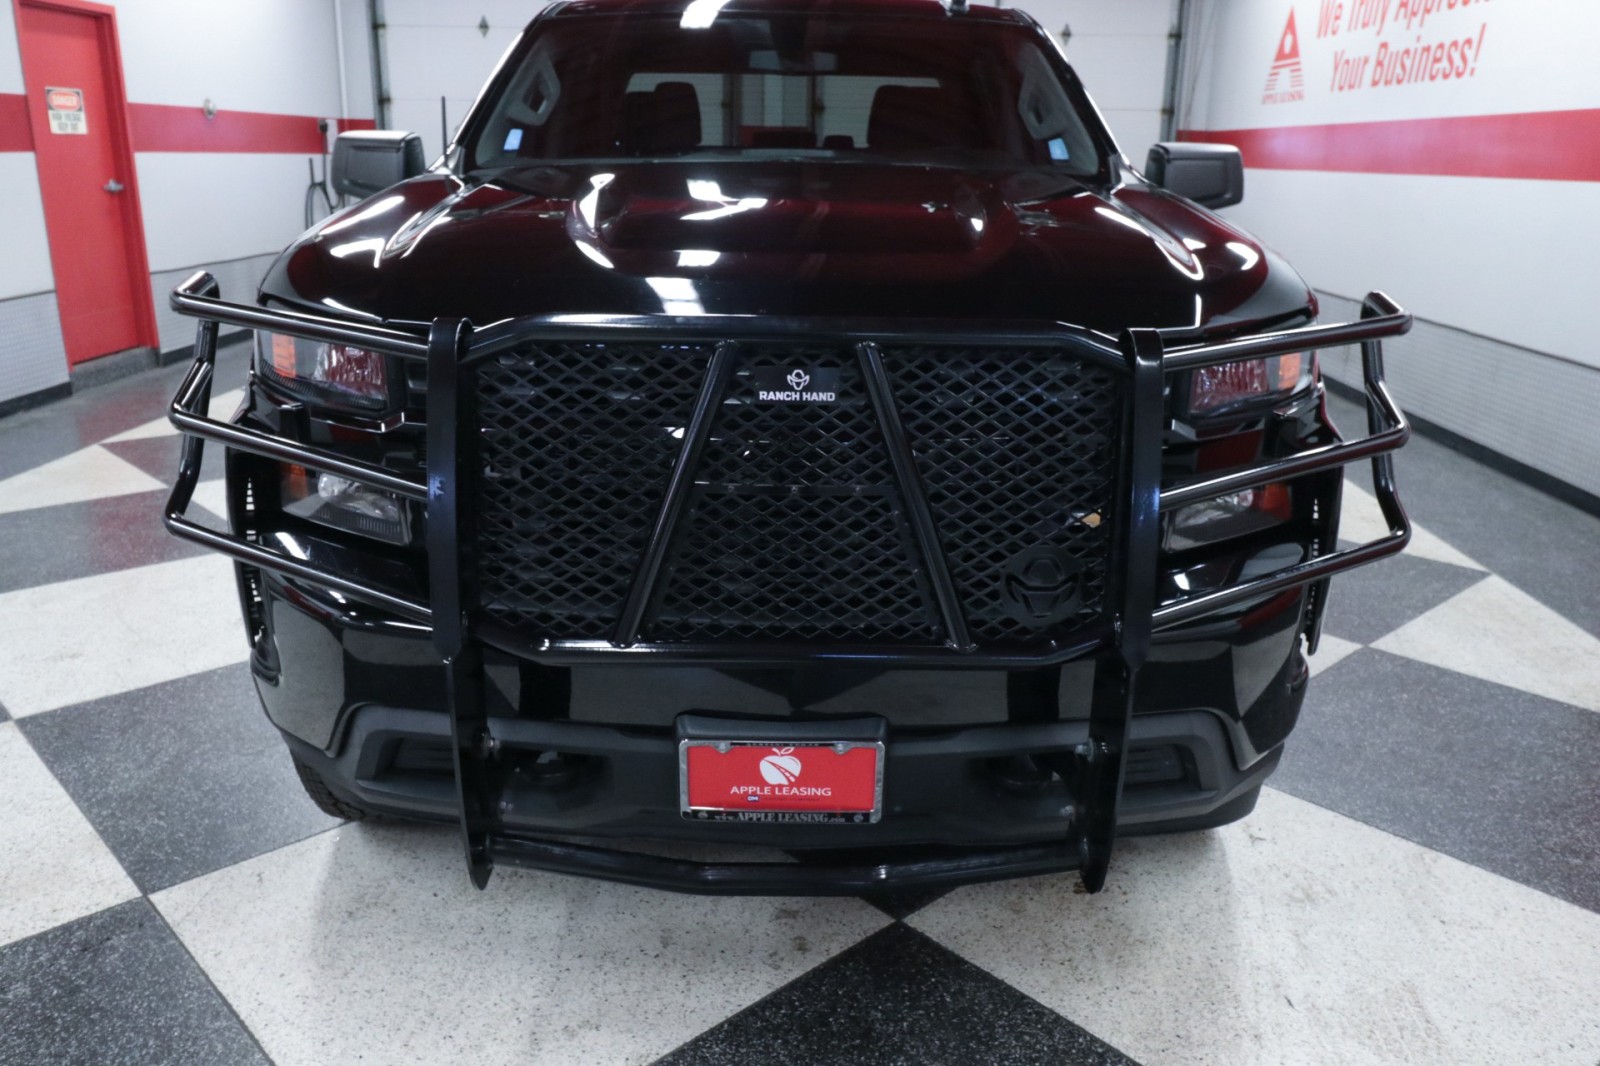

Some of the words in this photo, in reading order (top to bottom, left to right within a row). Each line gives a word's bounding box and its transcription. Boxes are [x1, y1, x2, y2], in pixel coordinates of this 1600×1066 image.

[1330, 50, 1370, 92] Your
[1370, 22, 1487, 88] Business!
[759, 391, 800, 401] RANCH
[802, 392, 836, 402] HAND
[730, 786, 772, 795] APPLE
[775, 787, 832, 797] LEASING
